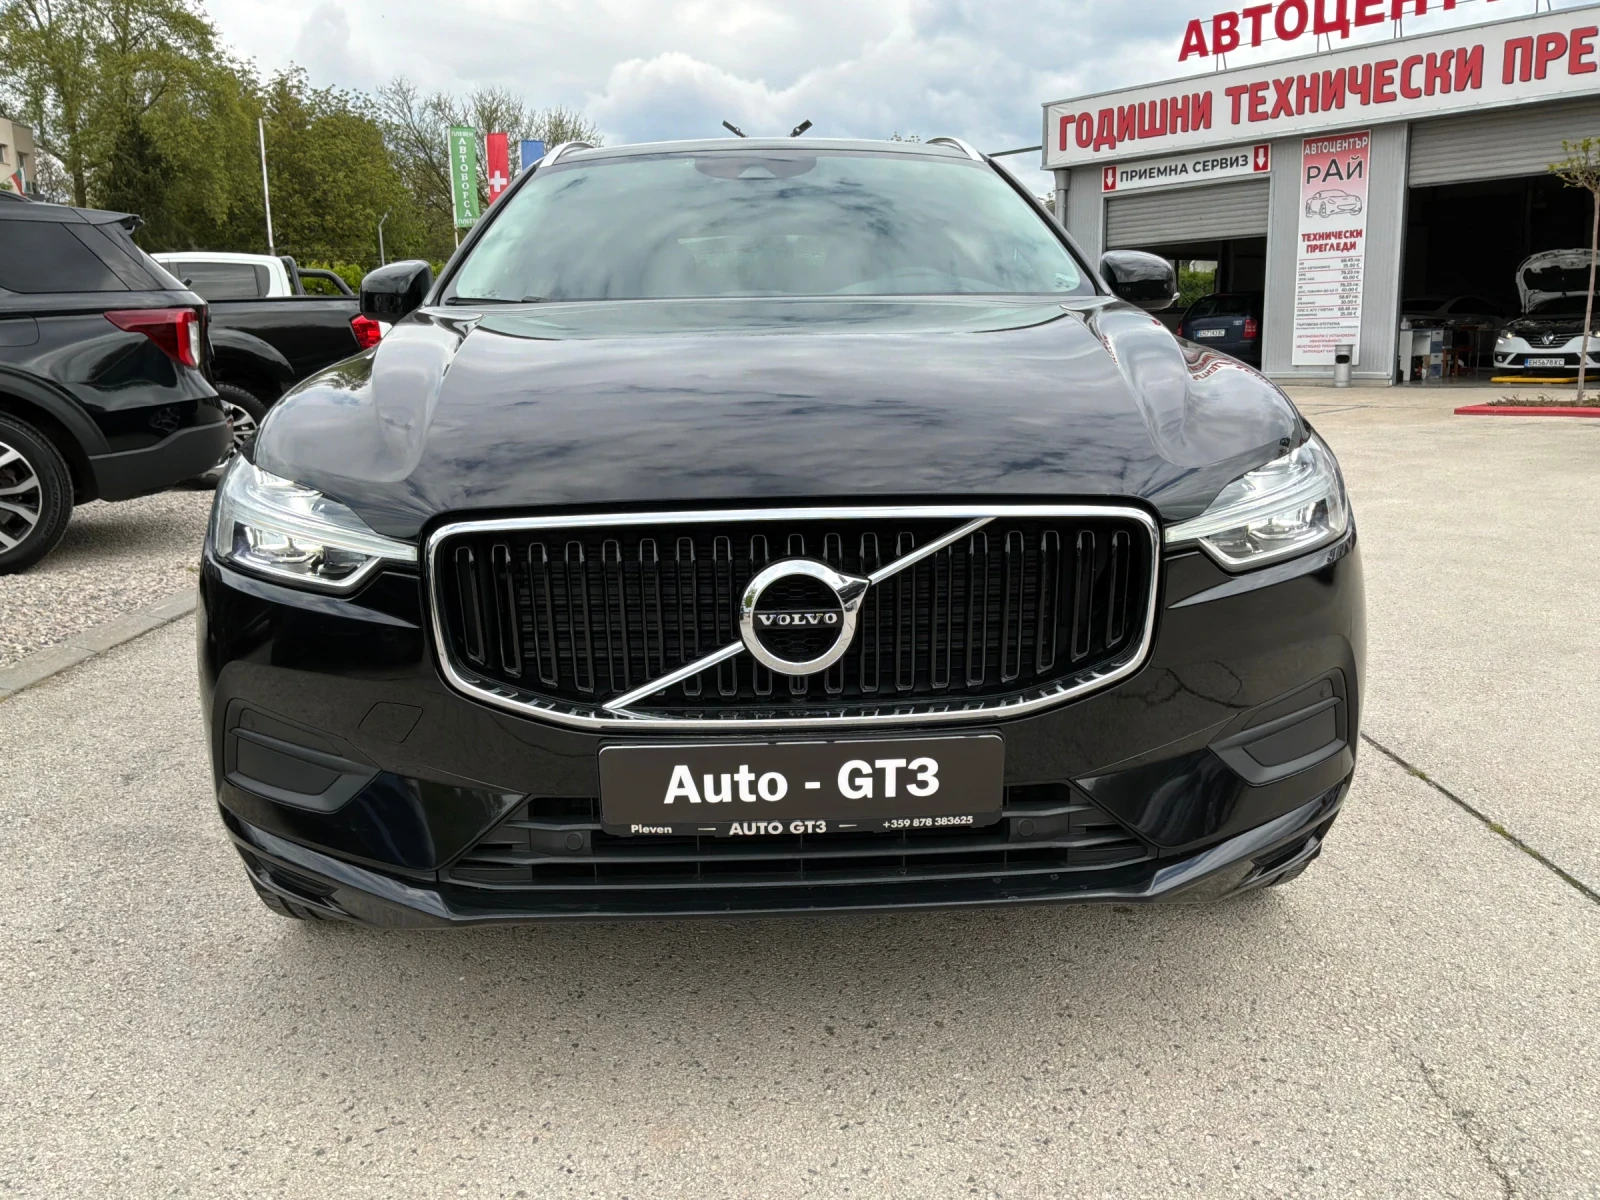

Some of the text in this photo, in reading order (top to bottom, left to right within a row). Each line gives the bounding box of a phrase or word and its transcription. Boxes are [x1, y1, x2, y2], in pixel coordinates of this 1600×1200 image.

[1059, 90, 1212, 152] ГОДИШНИ
[1224, 44, 1485, 125] ТЕХНИЧЕСКИ
[1304, 136, 1369, 155] АВТОЦЕНТЪР
[1120, 154, 1249, 183] ПРИЕМНА СЕРВИЗ
[1306, 155, 1363, 185] РАЙ
[1301, 229, 1363, 242] ТЕХНИЧЕСКИ
[1306, 241, 1357, 253] ПРЕГЛЕДИ
[758, 613, 838, 626] VOLVO
[663, 764, 788, 804] Auto
[837, 757, 940, 800] GT3
[631, 816, 974, 836] Pleven AUTO GT3 +359 878 383625
